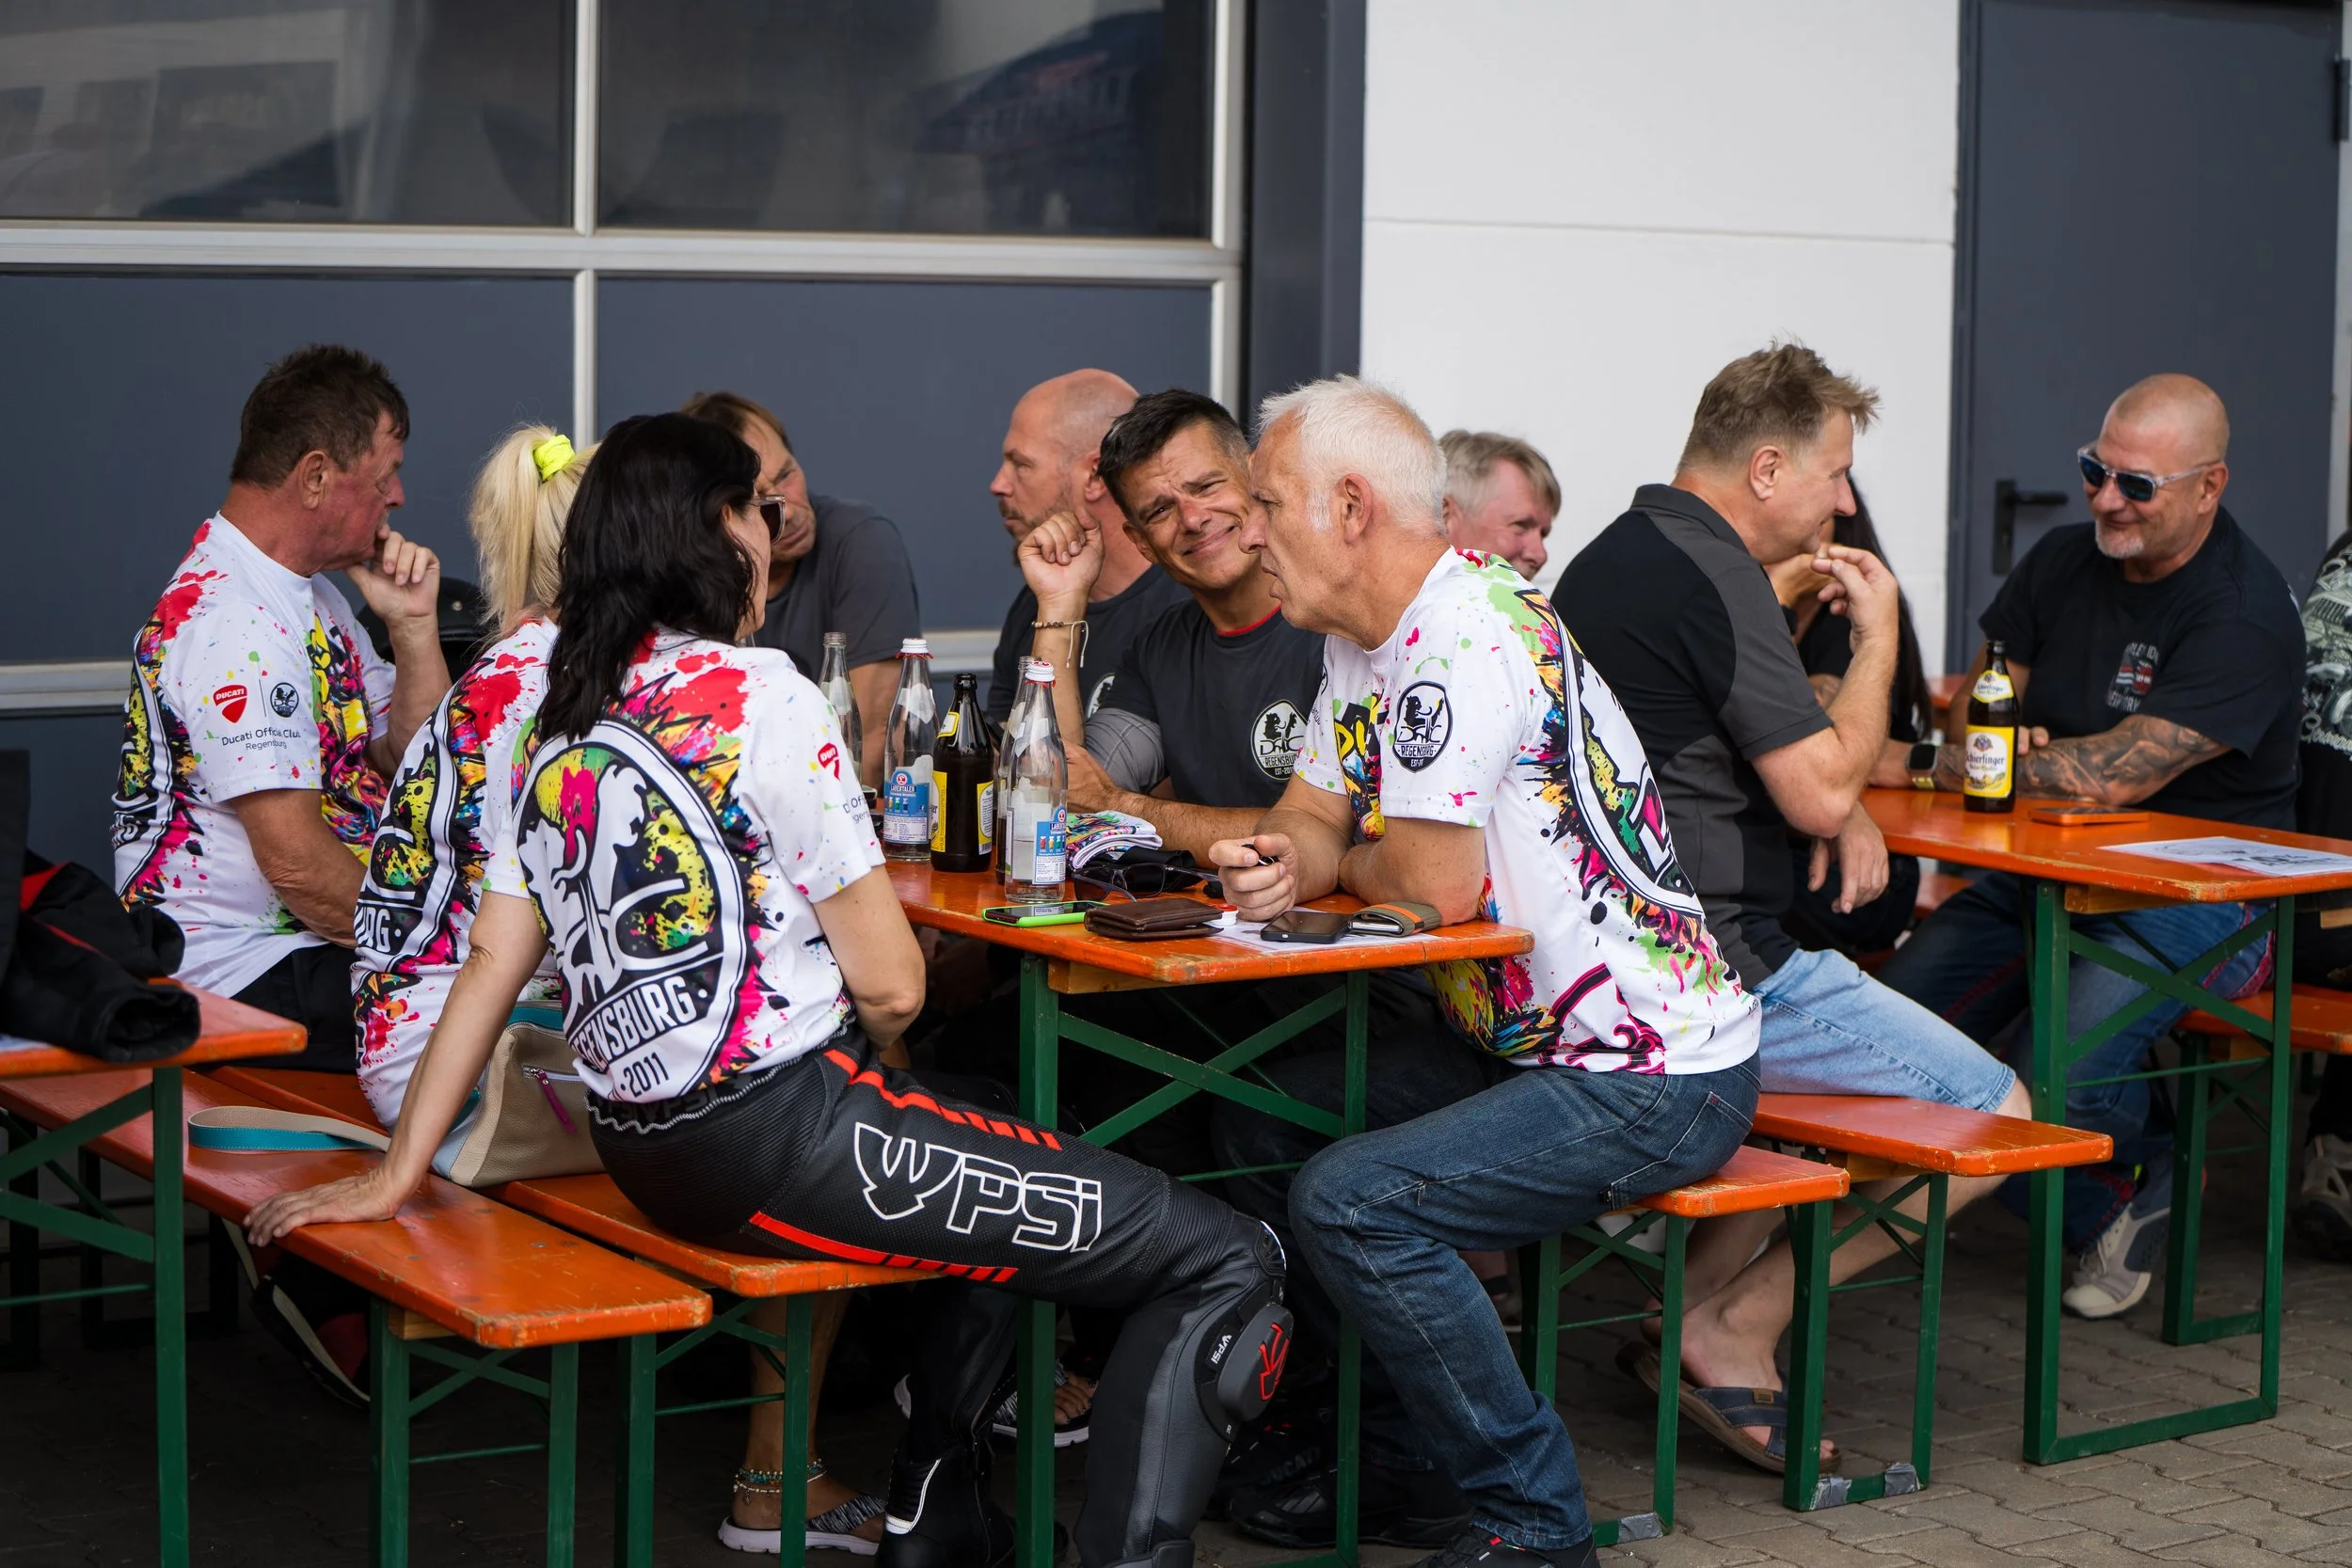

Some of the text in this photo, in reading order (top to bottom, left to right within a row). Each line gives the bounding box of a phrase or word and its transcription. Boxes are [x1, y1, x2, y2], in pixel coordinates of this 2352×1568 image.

[215, 689, 245, 700] DUCATI
[221, 731, 253, 746] Ducati
[623, 1052, 670, 1099] 2011
[1210, 1334, 1232, 1364] WPSI
